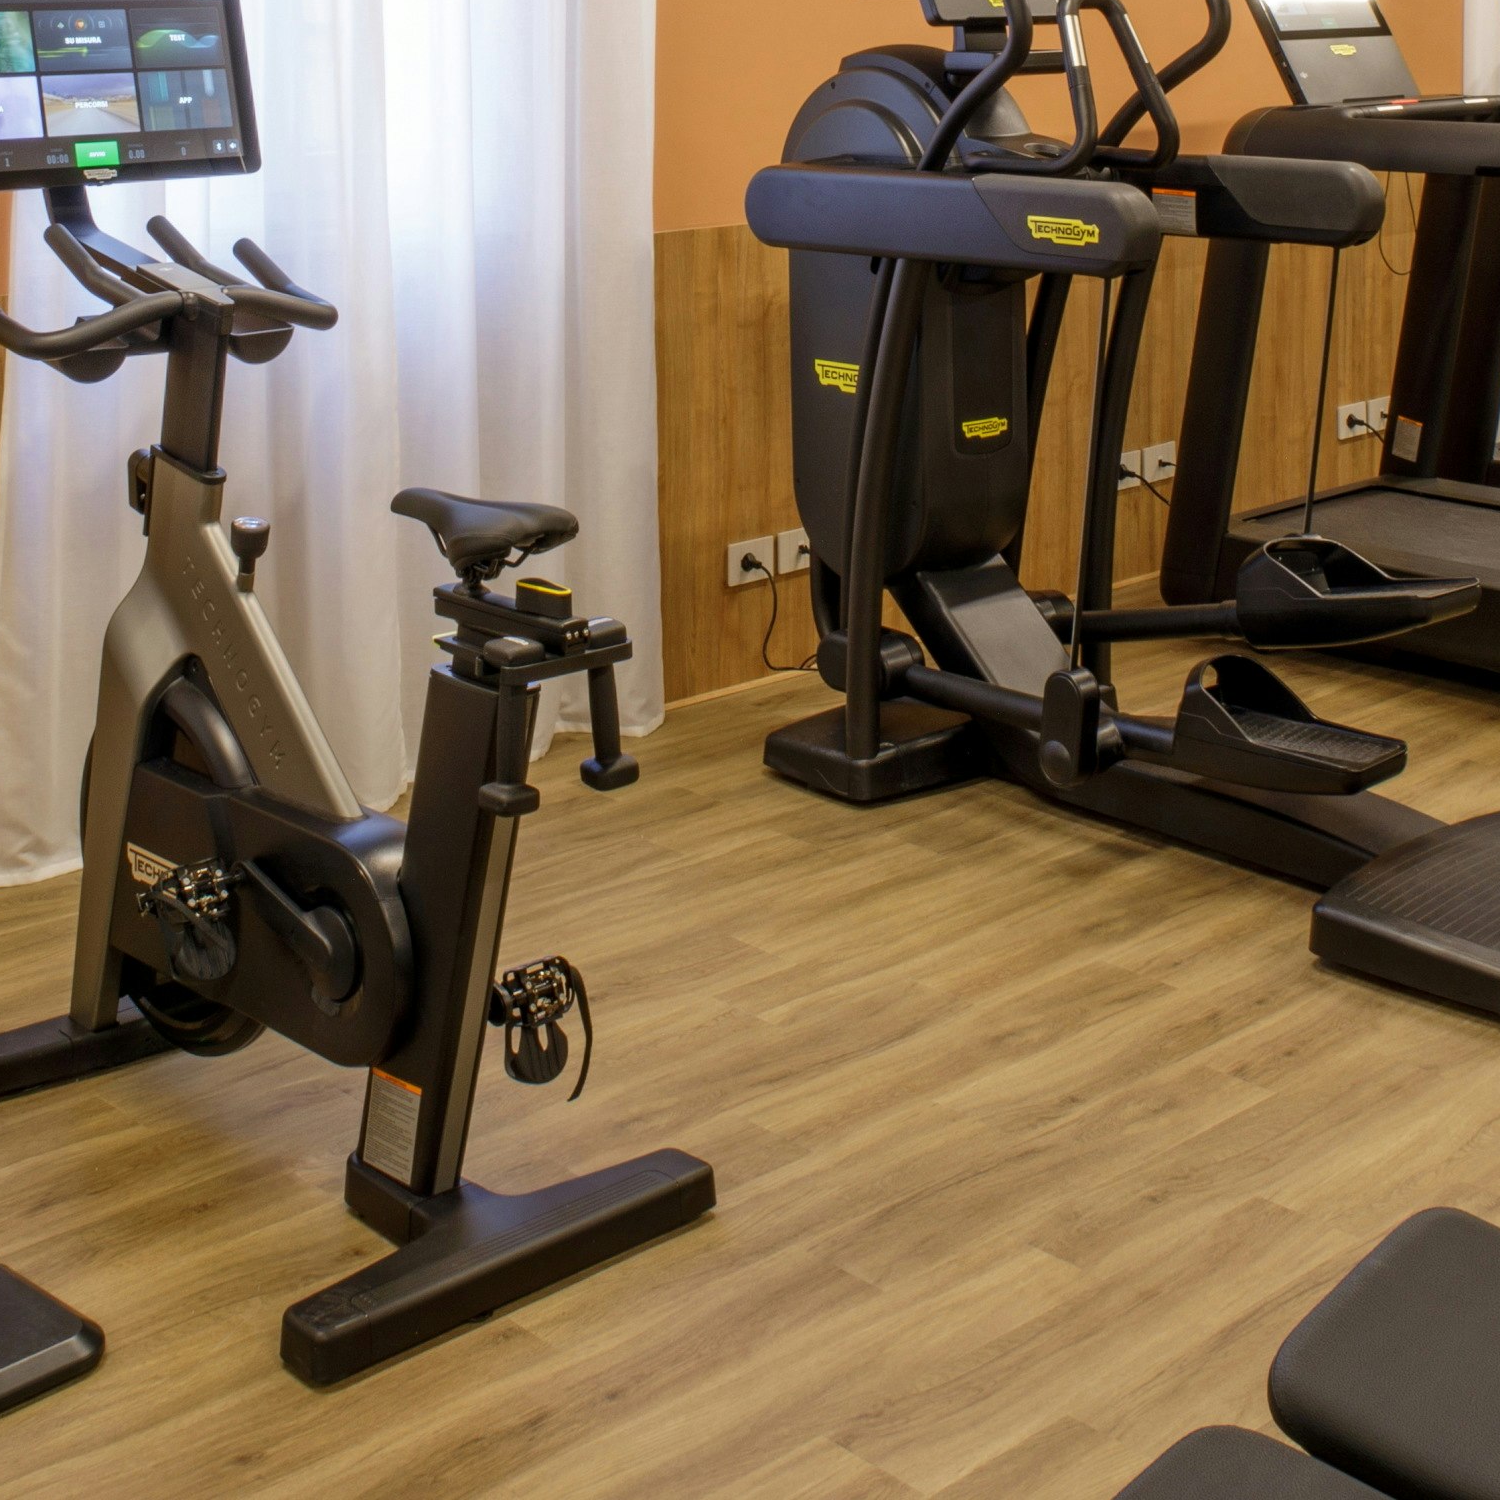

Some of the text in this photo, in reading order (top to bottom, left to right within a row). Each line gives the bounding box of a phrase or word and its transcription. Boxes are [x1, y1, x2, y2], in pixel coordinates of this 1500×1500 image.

[76, 36, 102, 44] MISURA
[169, 34, 186, 42] TEST
[179, 96, 193, 104] APP
[75, 101, 108, 109] PERCORSI
